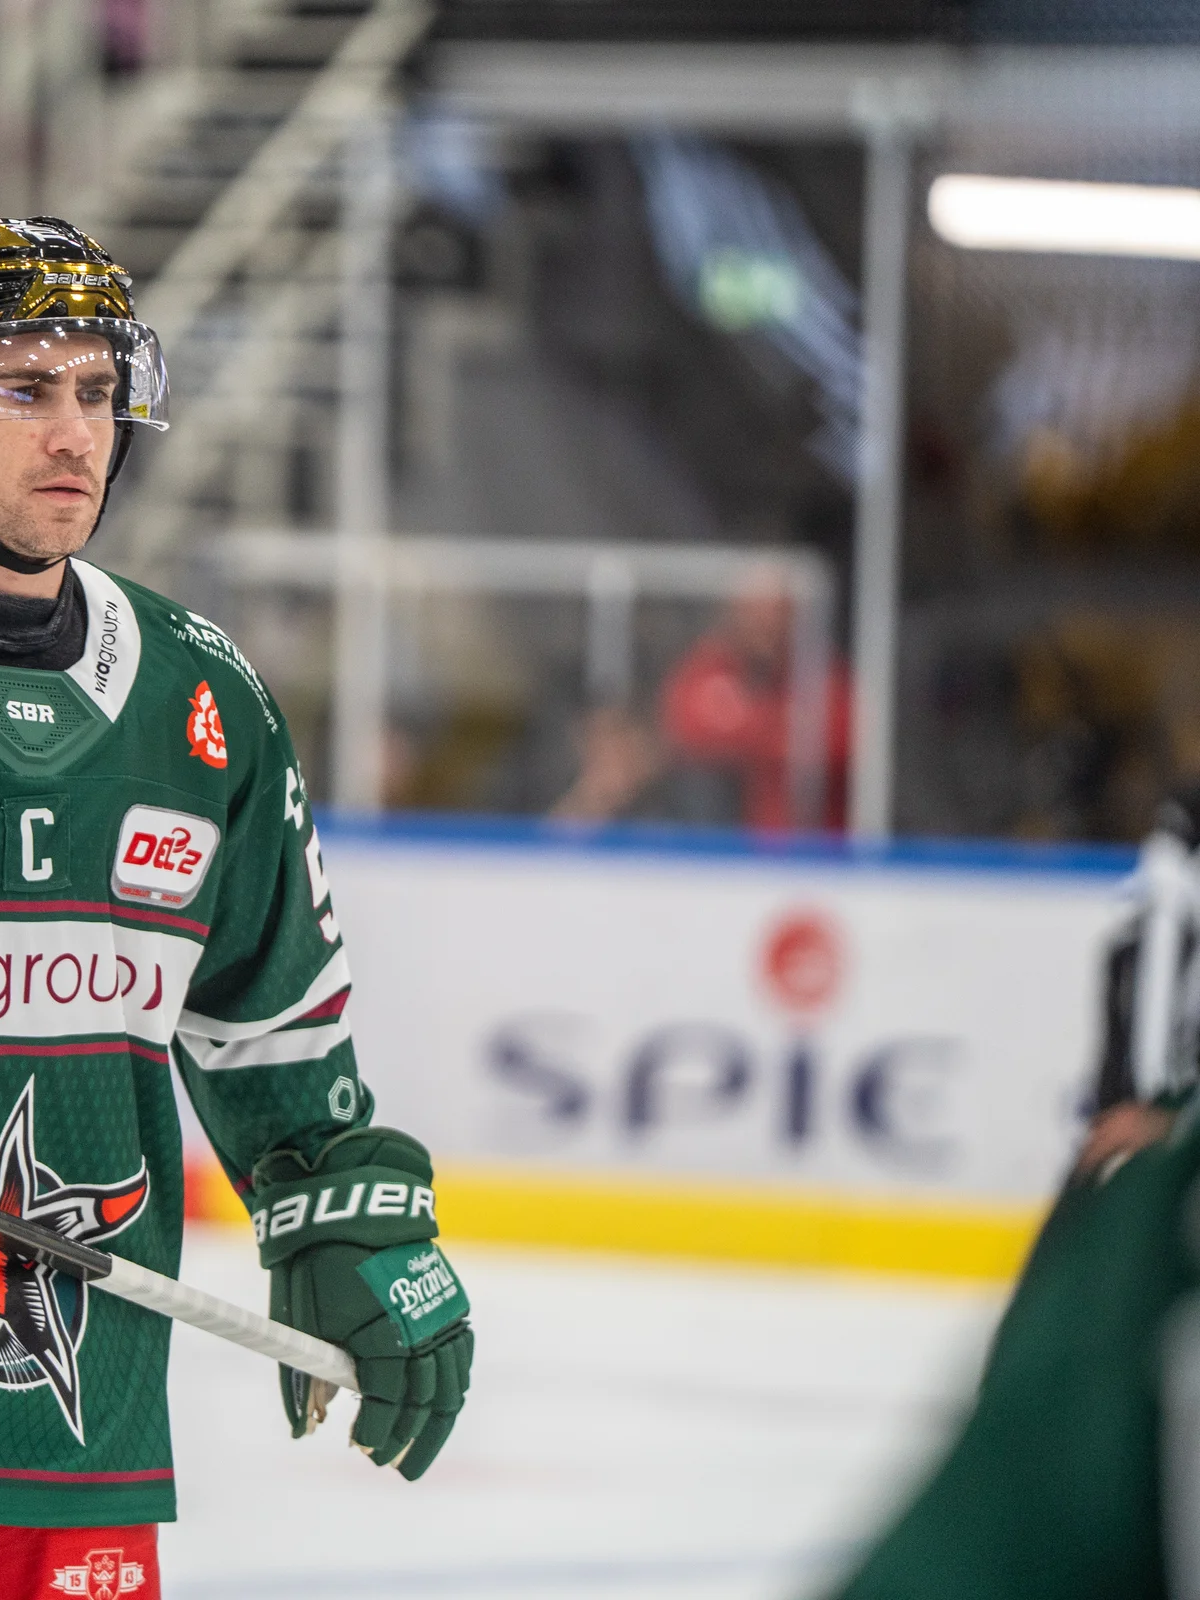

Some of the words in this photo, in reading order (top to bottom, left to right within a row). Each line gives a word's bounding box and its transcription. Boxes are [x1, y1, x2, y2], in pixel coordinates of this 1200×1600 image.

[43, 273, 111, 287] BAUER
[5, 700, 56, 724] SBR
[19, 808, 55, 882] C
[251, 1181, 437, 1245] BAUER
[389, 1256, 455, 1315] Brand
[69, 1574, 82, 1588] 15
[124, 1571, 135, 1585] 43
